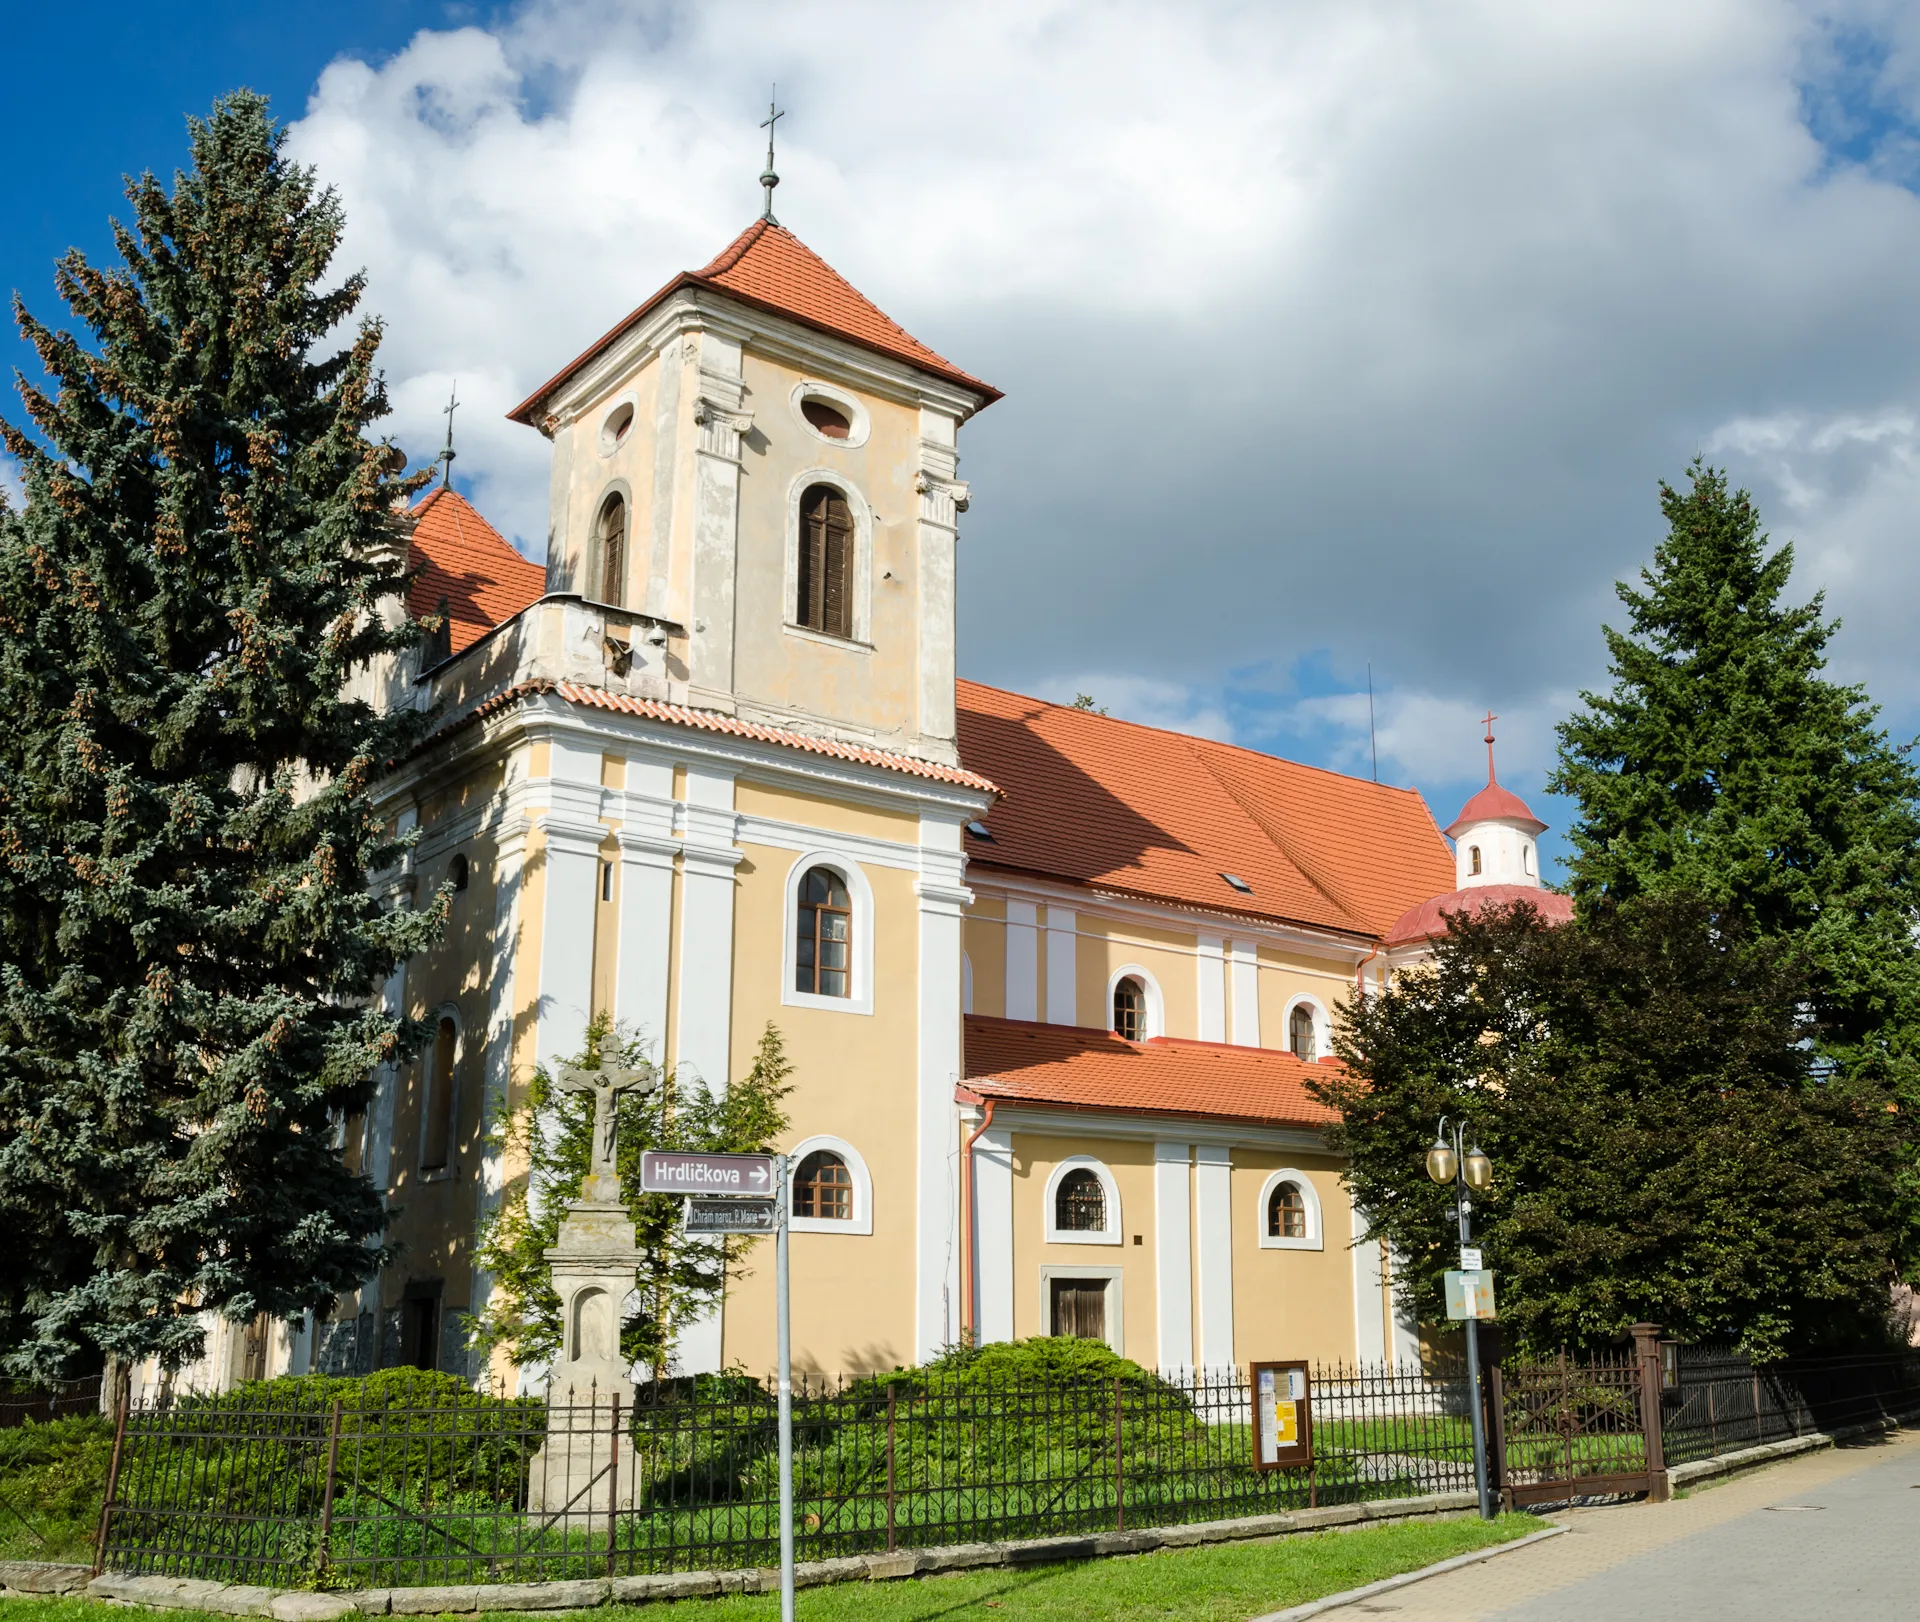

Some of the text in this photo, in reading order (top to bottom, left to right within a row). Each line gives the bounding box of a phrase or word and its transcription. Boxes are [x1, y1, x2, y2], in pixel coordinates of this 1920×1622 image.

[655, 1161, 740, 1183] Hrdličkova
[693, 1208, 714, 1224] Chrám
[741, 1209, 758, 1224] Marie
